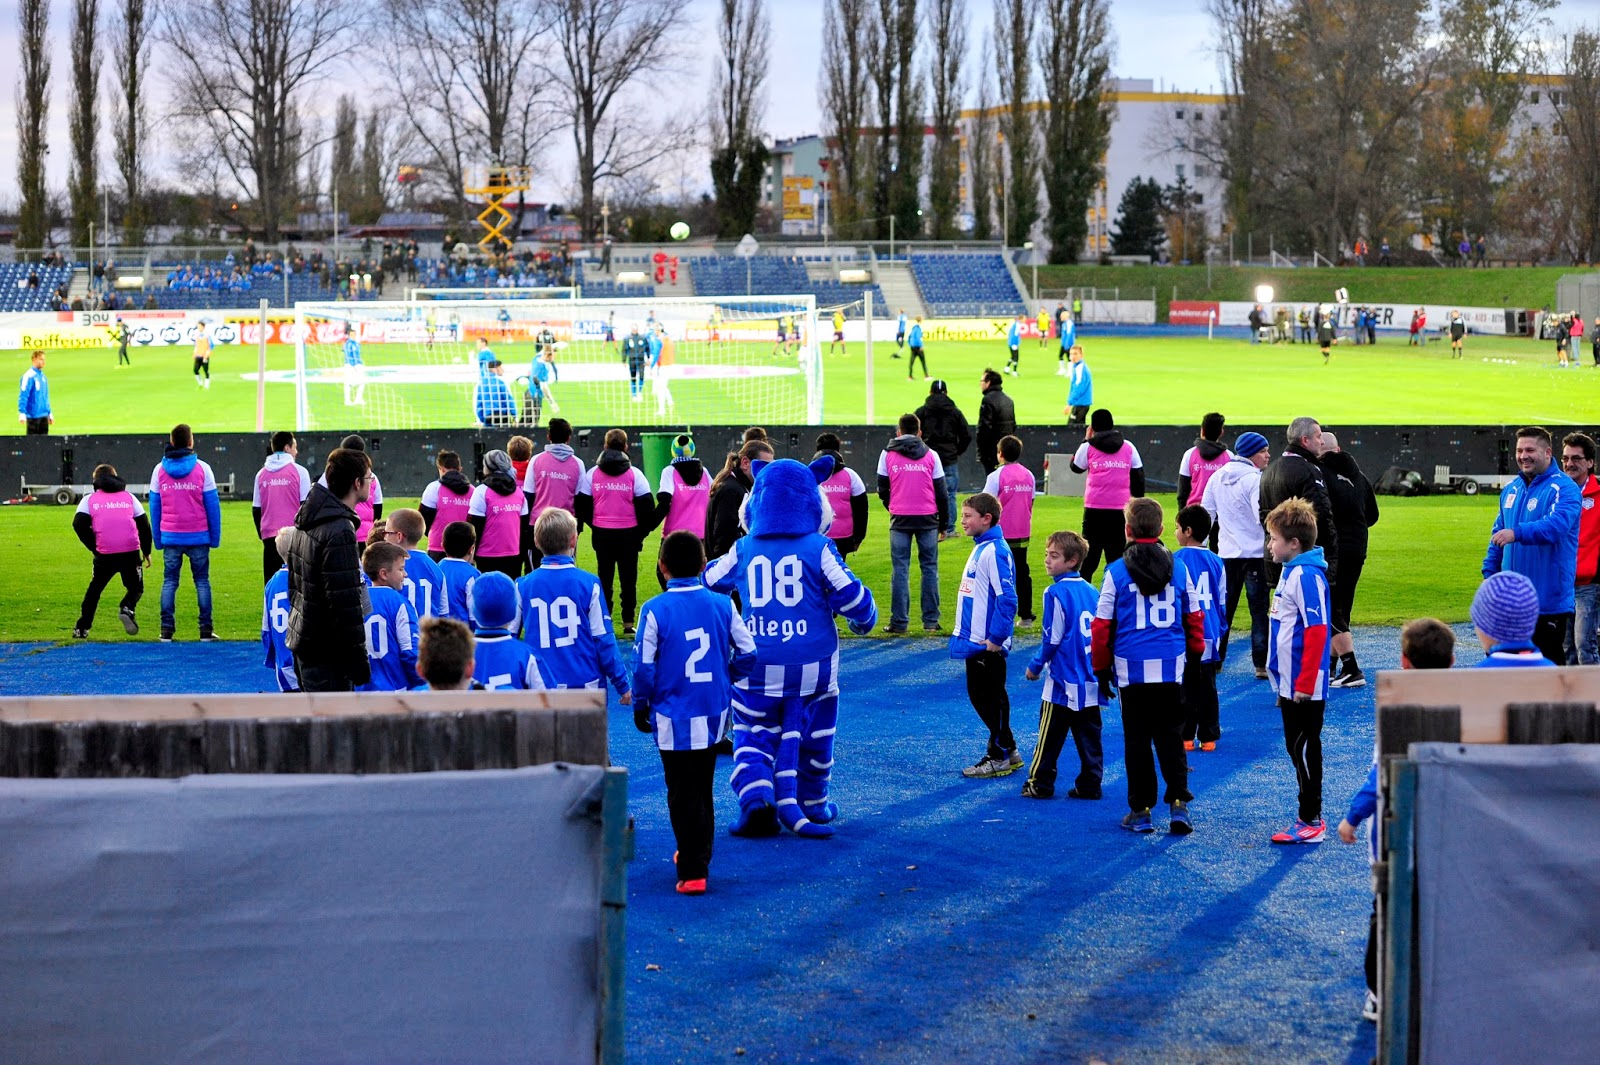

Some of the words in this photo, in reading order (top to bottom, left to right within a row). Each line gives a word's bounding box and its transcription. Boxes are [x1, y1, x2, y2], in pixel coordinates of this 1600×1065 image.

[23, 333, 102, 347] Raiffeisen
[921, 325, 988, 341] aiffeisen
[747, 554, 803, 608] 08
[1195, 571, 1213, 610] 4
[530, 596, 582, 649] 19
[747, 614, 807, 643] diego
[1128, 582, 1176, 630] 18
[364, 614, 388, 659] 0
[684, 627, 713, 683] 2
